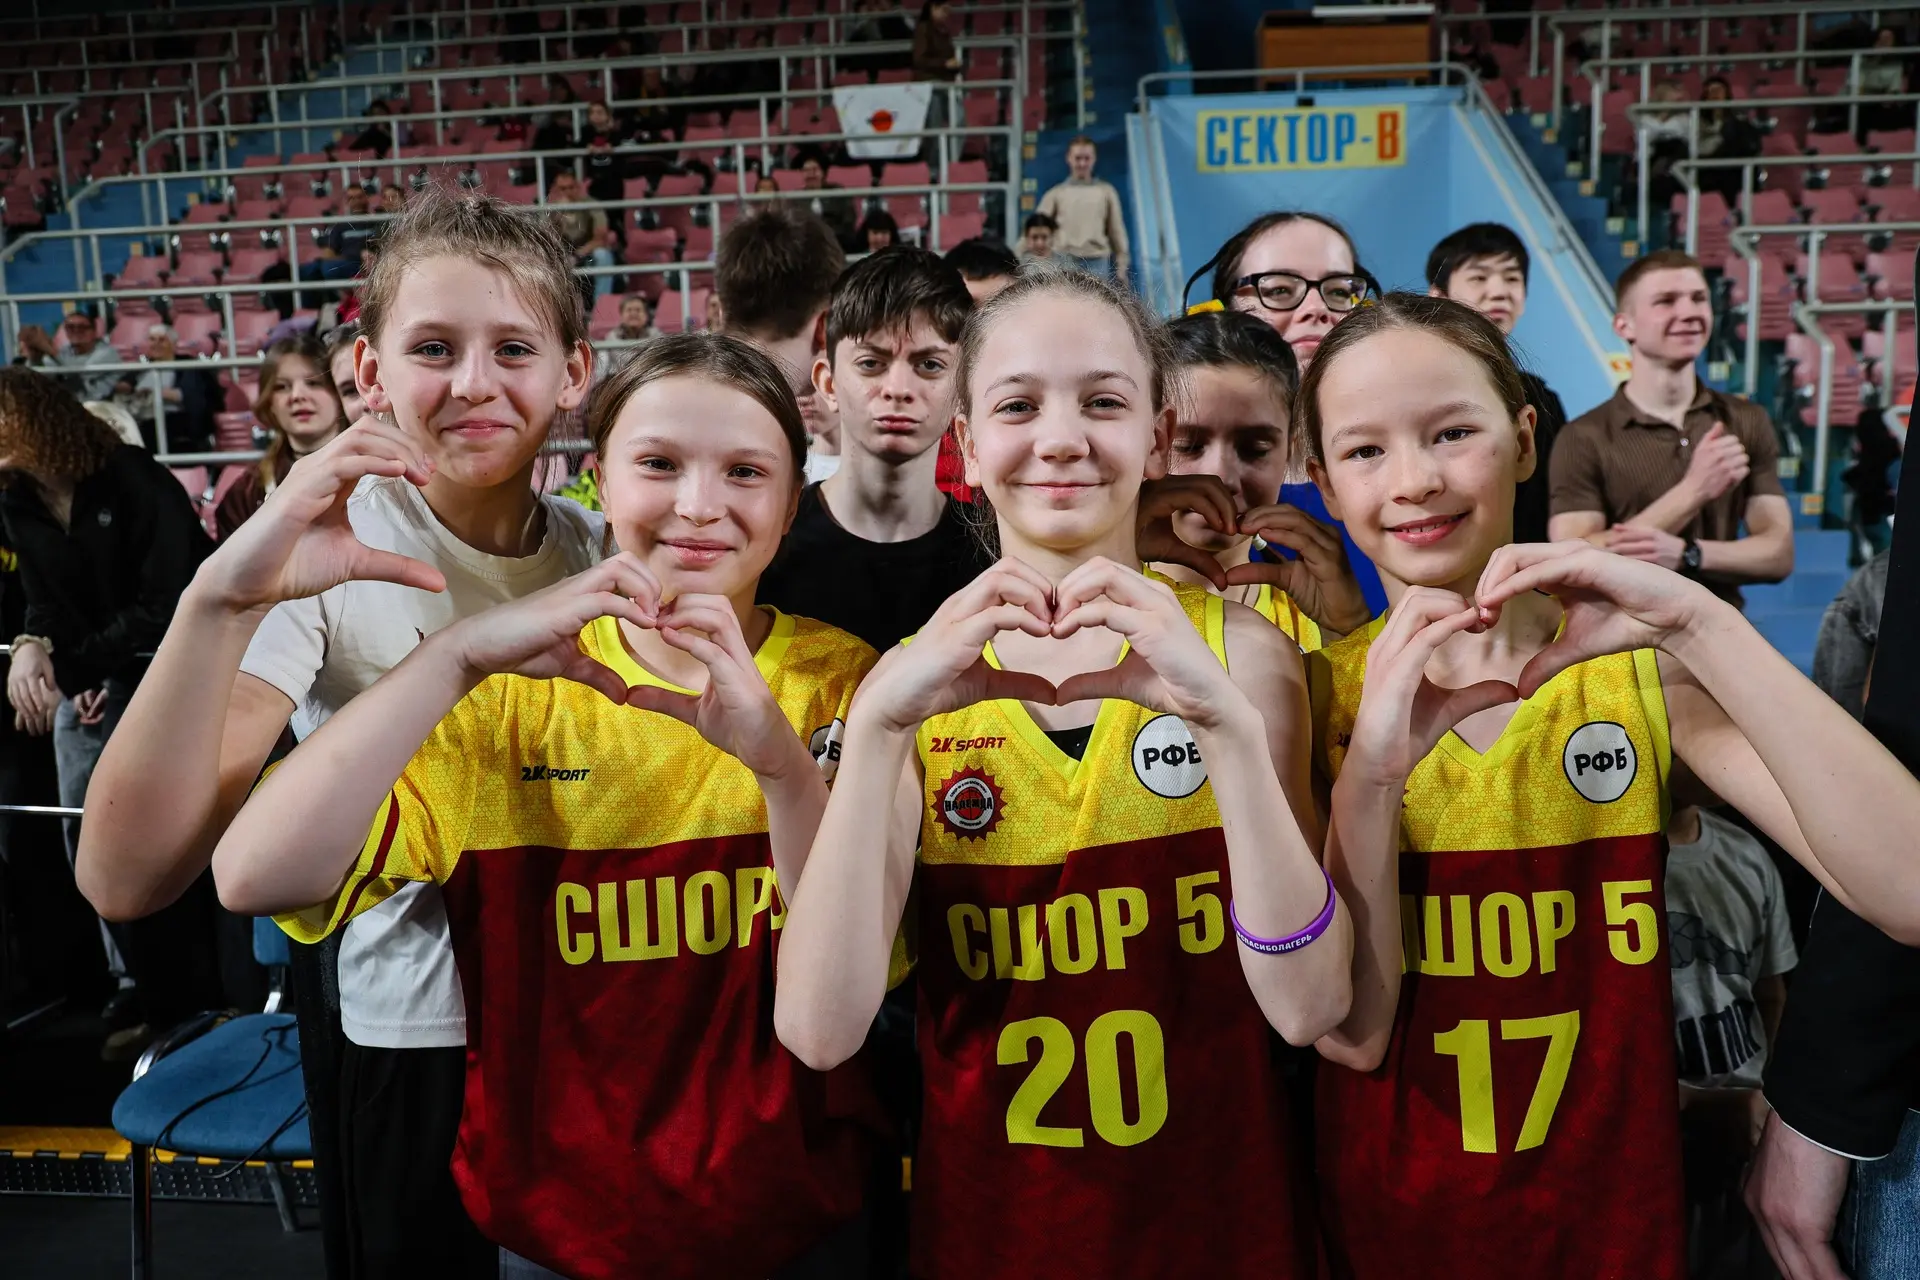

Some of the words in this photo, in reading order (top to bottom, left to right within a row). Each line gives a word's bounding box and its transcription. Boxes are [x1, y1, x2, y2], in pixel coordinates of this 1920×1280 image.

[1206, 111, 1399, 167] СЕКТОР-В
[520, 764, 547, 781] 2K
[547, 768, 591, 781] SPORT
[930, 737, 955, 753] 2K
[956, 737, 1007, 752] SPORT
[1573, 746, 1628, 776] РФБ
[556, 866, 788, 965] СШОР
[947, 886, 1150, 981] СШОР
[1175, 870, 1225, 954] 5
[1402, 889, 1576, 978] ШОР
[1601, 879, 1659, 965] 5
[996, 1009, 1168, 1147] 20
[1433, 1009, 1580, 1153] 17
